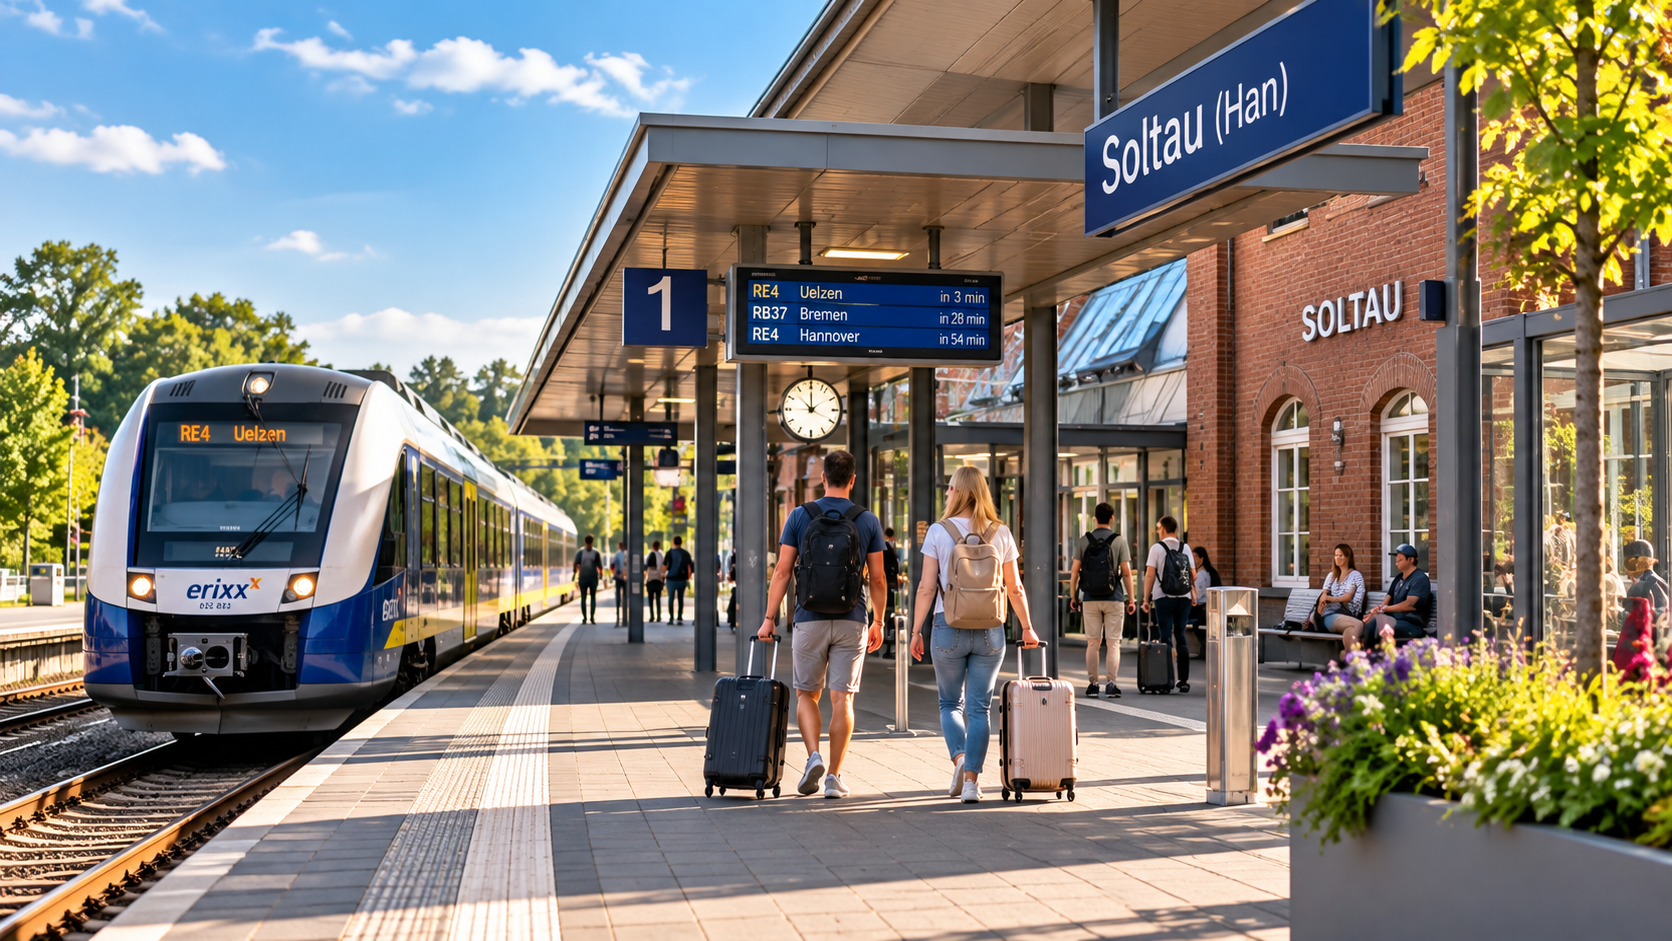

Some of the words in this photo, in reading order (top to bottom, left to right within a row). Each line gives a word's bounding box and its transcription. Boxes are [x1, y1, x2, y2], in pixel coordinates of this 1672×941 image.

[1102, 104, 1203, 194] Soltau
[1216, 61, 1288, 145] (Han)
[647, 276, 671, 331] 1
[753, 284, 779, 298] RE4
[800, 286, 843, 300] Uelzen
[940, 290, 950, 303] in
[954, 291, 961, 303] 3
[965, 292, 985, 304] min
[752, 306, 787, 320] RB37
[800, 307, 848, 321] Bremen
[939, 312, 949, 325] in
[951, 312, 964, 325] 28
[966, 313, 985, 325] min
[1302, 280, 1403, 342] SOLTAU
[752, 327, 779, 341] RE4
[800, 328, 860, 343] Hannover
[939, 333, 949, 345] in
[951, 333, 964, 346] 54
[966, 334, 985, 346] min
[180, 424, 211, 442] RE4
[234, 425, 286, 442] Uelzen
